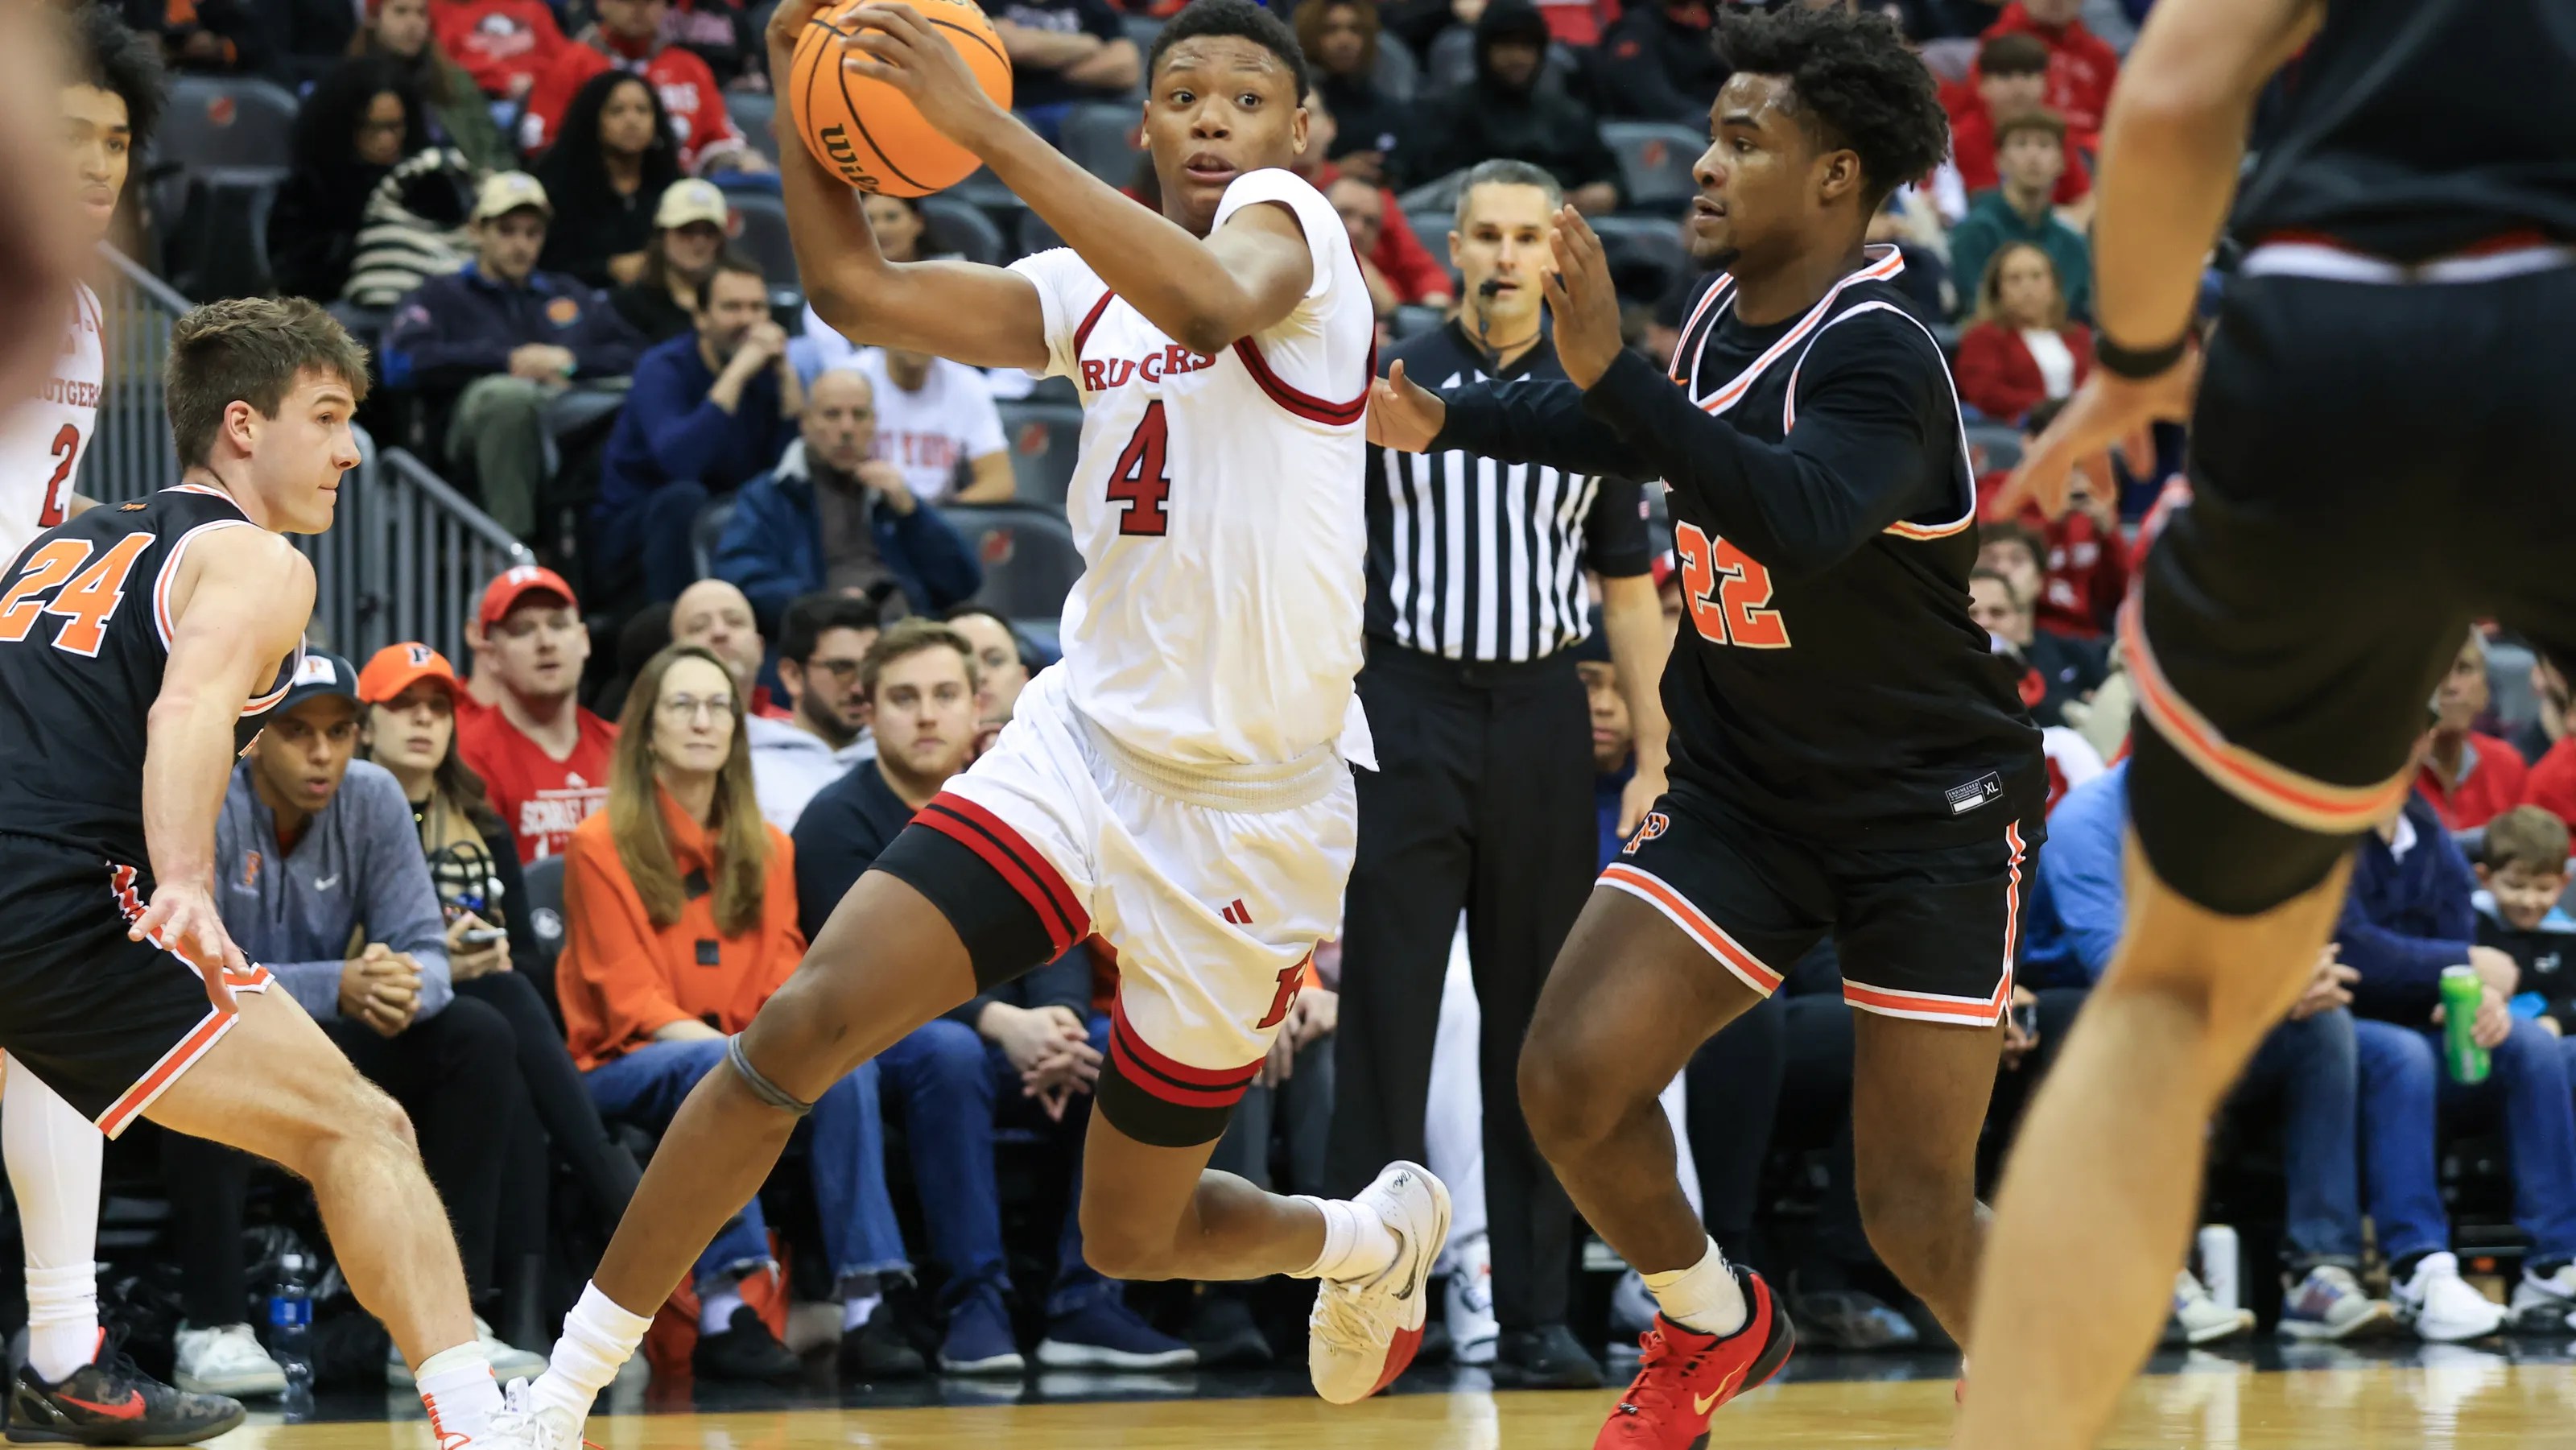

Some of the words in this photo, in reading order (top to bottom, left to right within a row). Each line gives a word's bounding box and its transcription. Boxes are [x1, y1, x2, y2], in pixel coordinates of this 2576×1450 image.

[37, 423, 80, 527] 2
[1105, 399, 1170, 536] 4
[0, 531, 156, 659] 24
[1675, 519, 1792, 649] 22
[1622, 812, 1670, 855] P
[1984, 781, 1999, 795] XL
